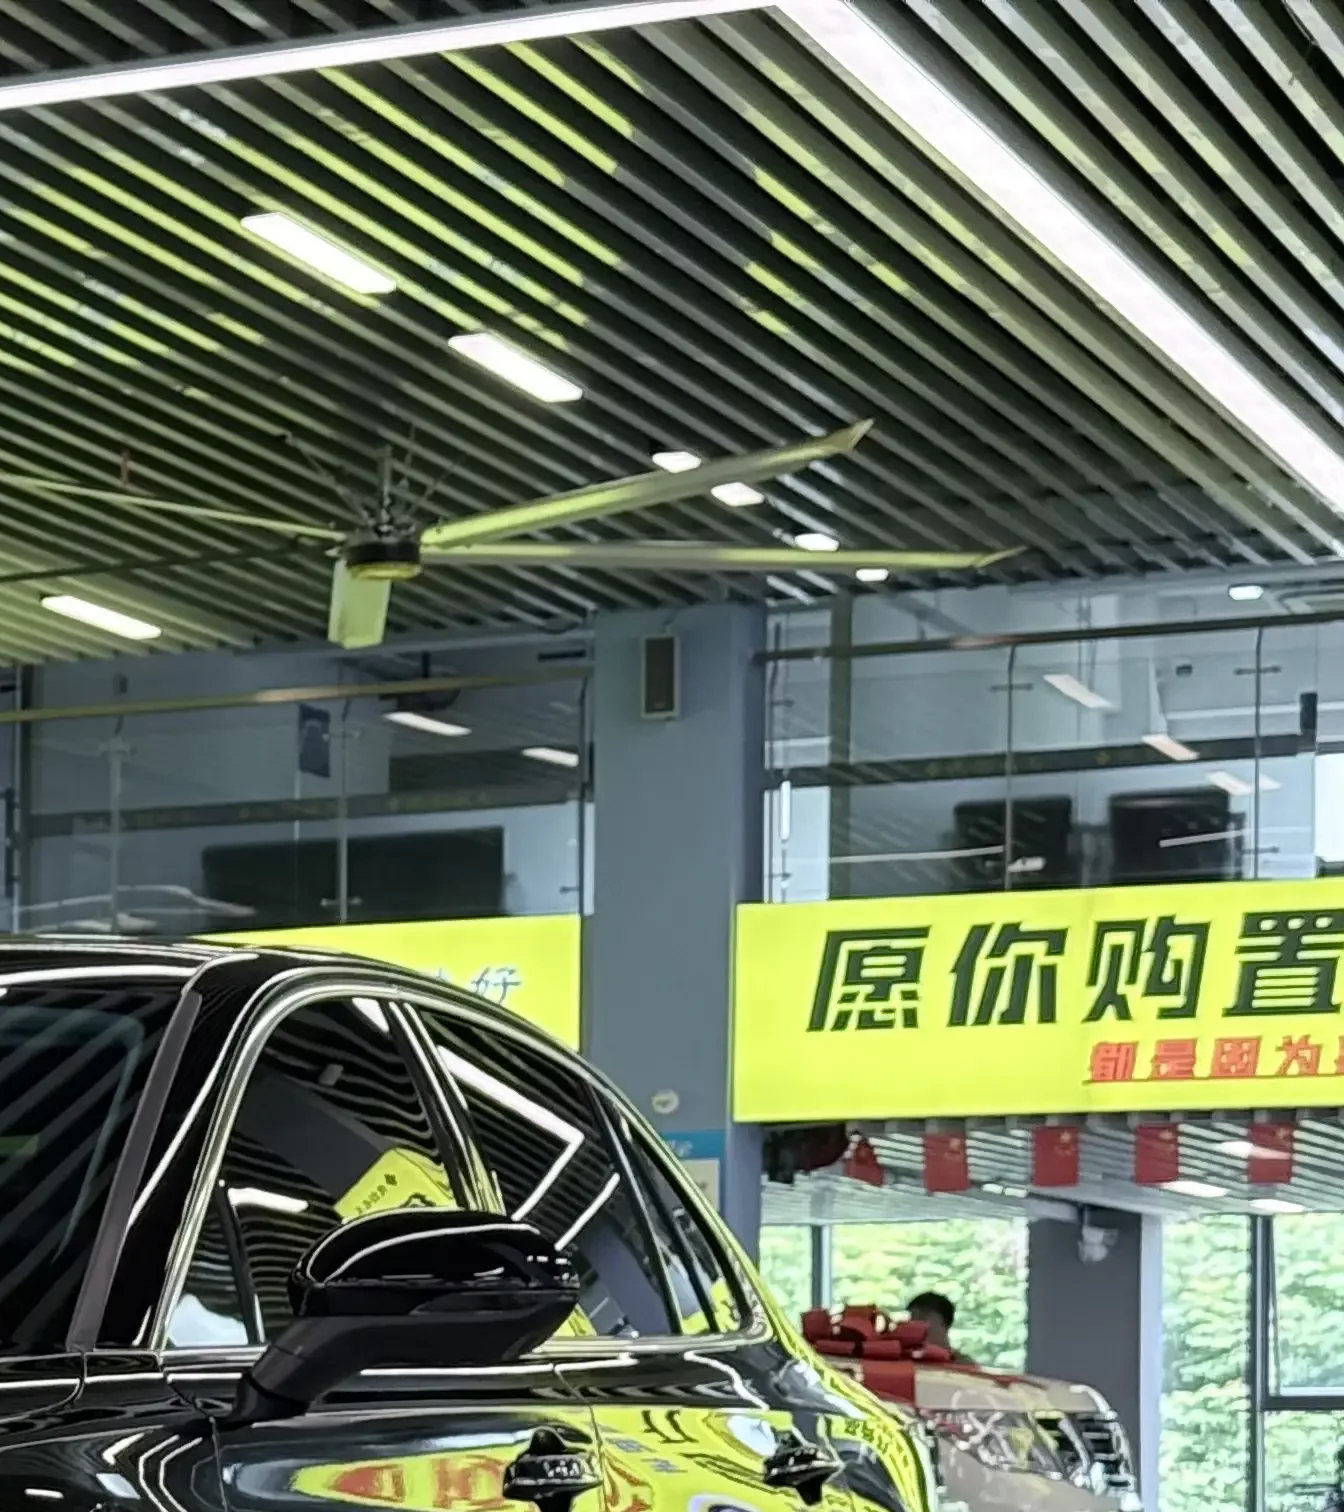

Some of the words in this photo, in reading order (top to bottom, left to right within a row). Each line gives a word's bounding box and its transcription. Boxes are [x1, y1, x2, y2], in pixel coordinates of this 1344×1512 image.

[806, 908, 1342, 1032] 愿你购置
[1088, 1034, 1344, 1081] 都是因为
